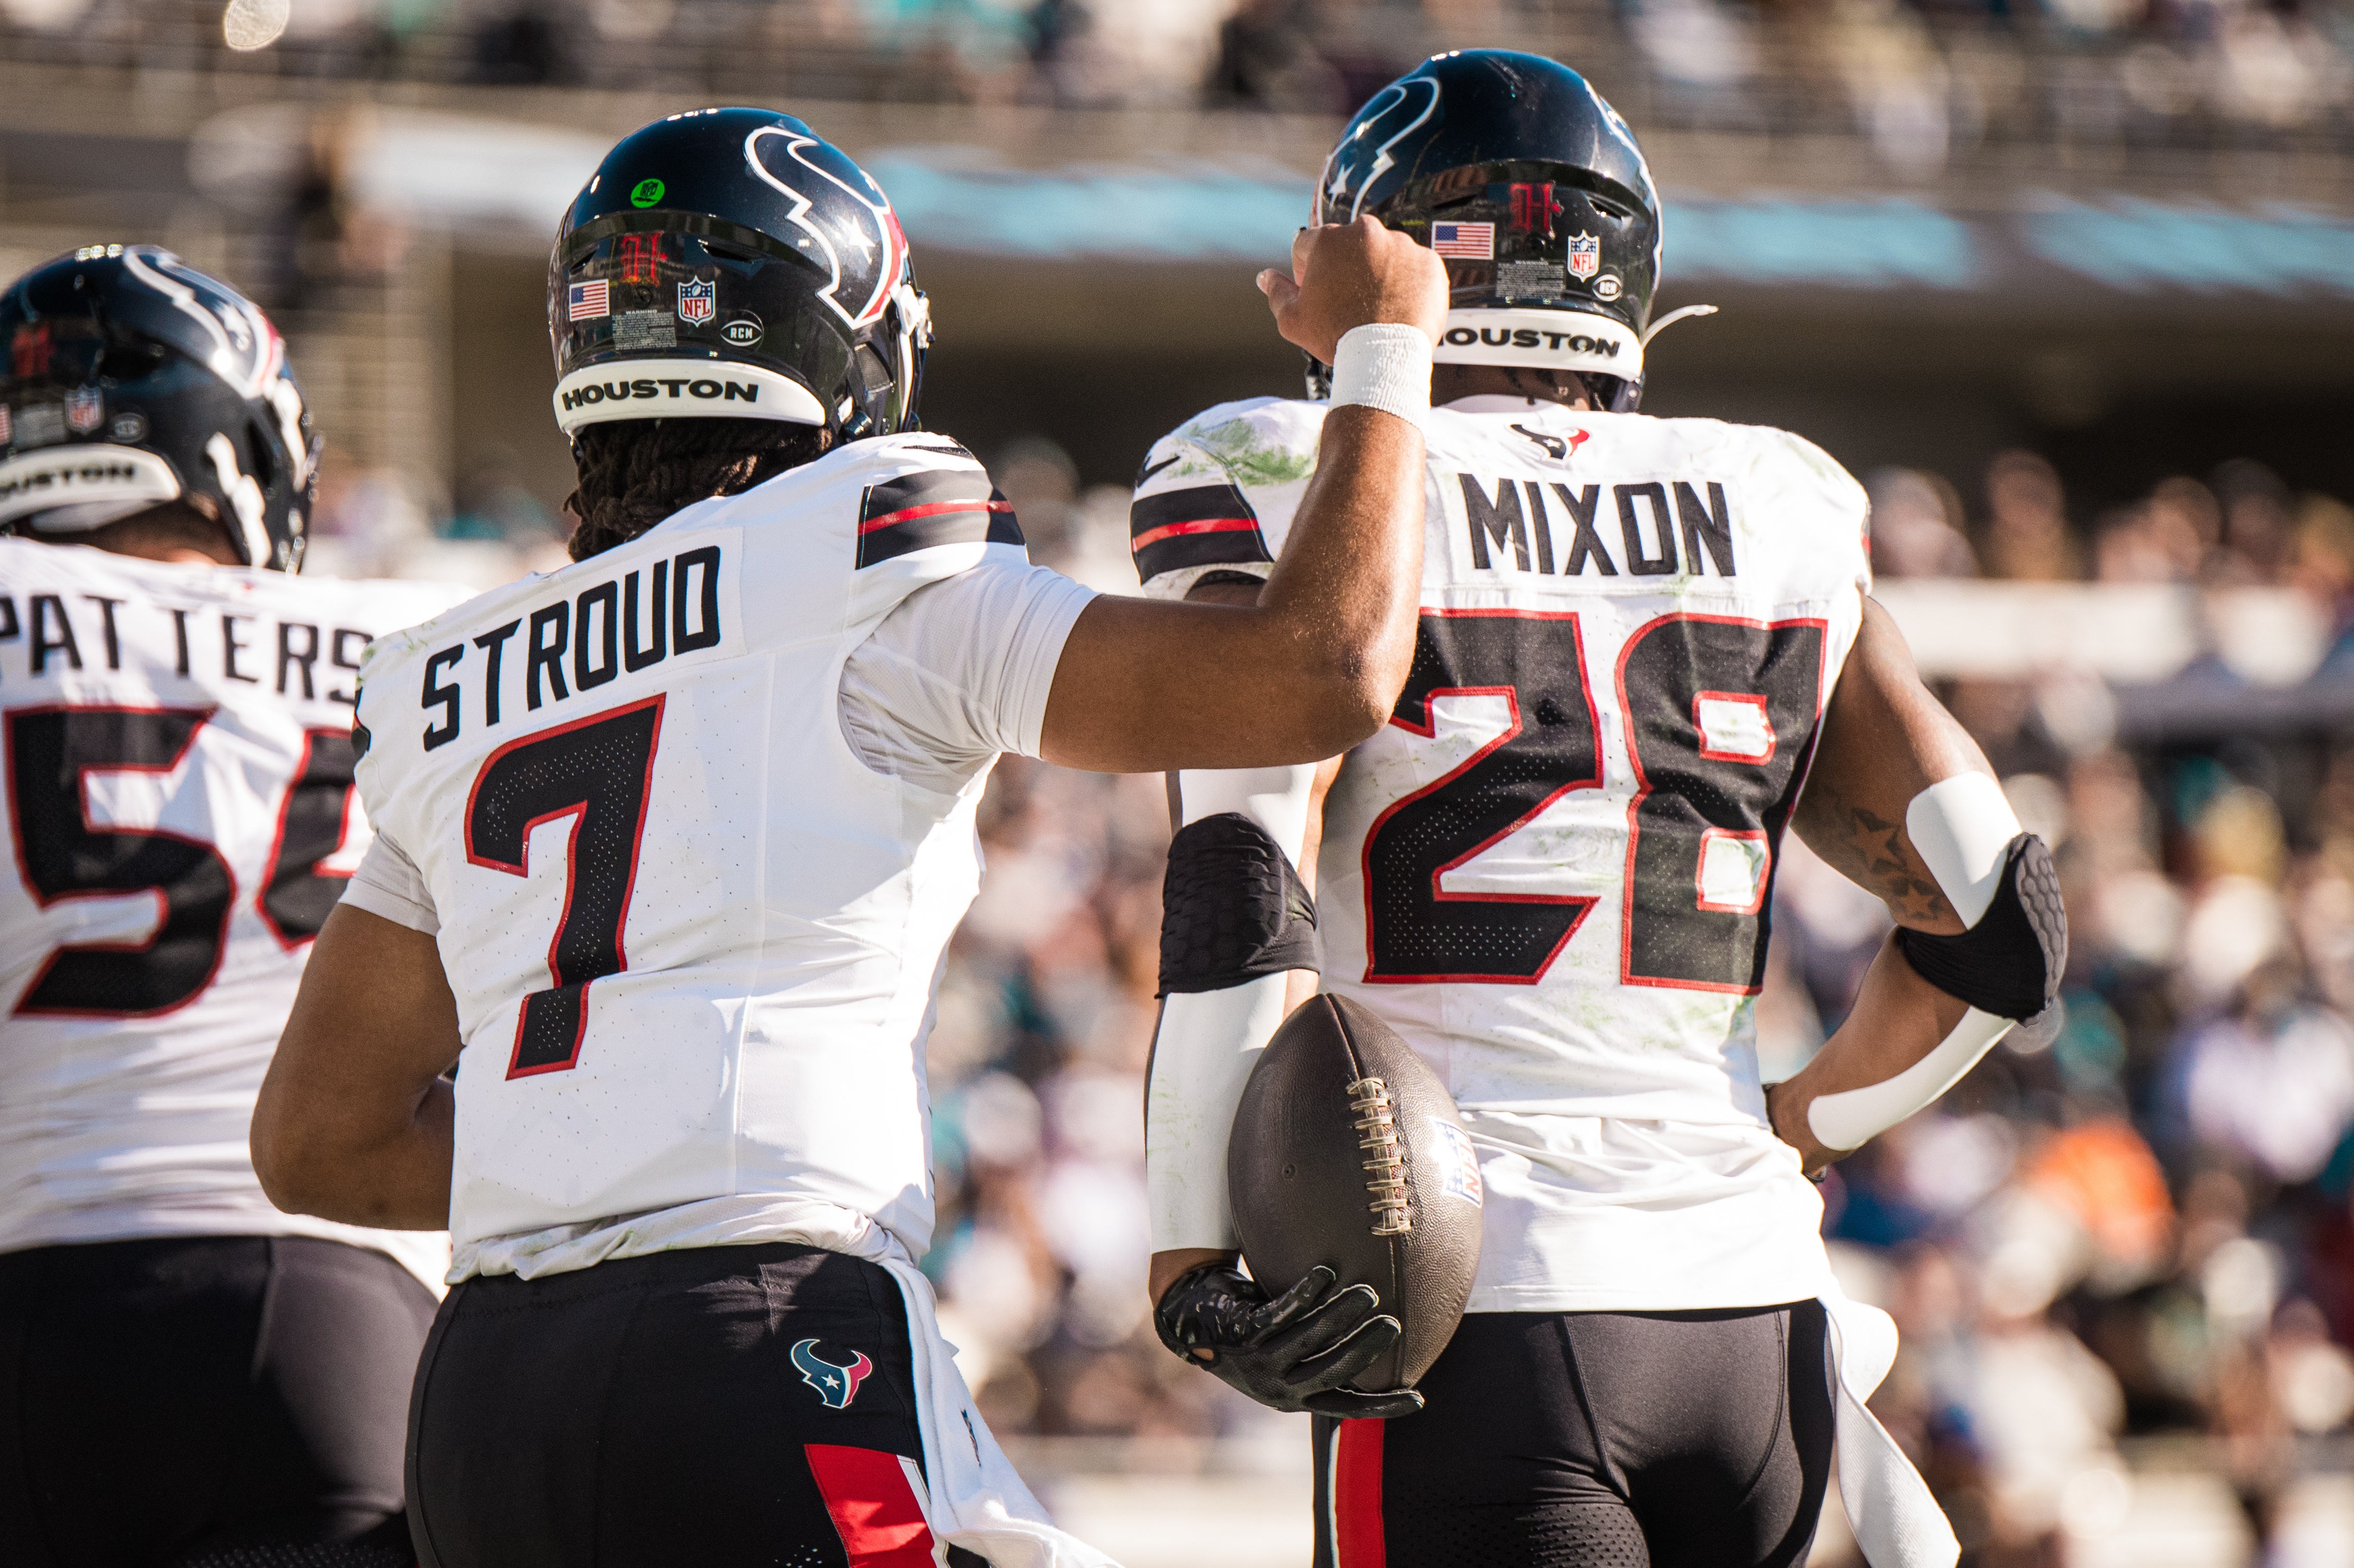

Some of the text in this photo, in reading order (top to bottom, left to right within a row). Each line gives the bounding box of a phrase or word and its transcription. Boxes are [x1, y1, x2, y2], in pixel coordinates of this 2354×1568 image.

[1573, 254, 1595, 271] NFL
[683, 299, 710, 318] NFL
[730, 327, 753, 339] RCM
[1433, 327, 1620, 358] OUSTON
[561, 379, 759, 411] HOUSTON
[0, 460, 136, 498] USTON
[1457, 473, 1737, 576] MIXON
[421, 545, 721, 752] STROUD
[1362, 607, 1828, 996] 28
[464, 691, 667, 1081] 7
